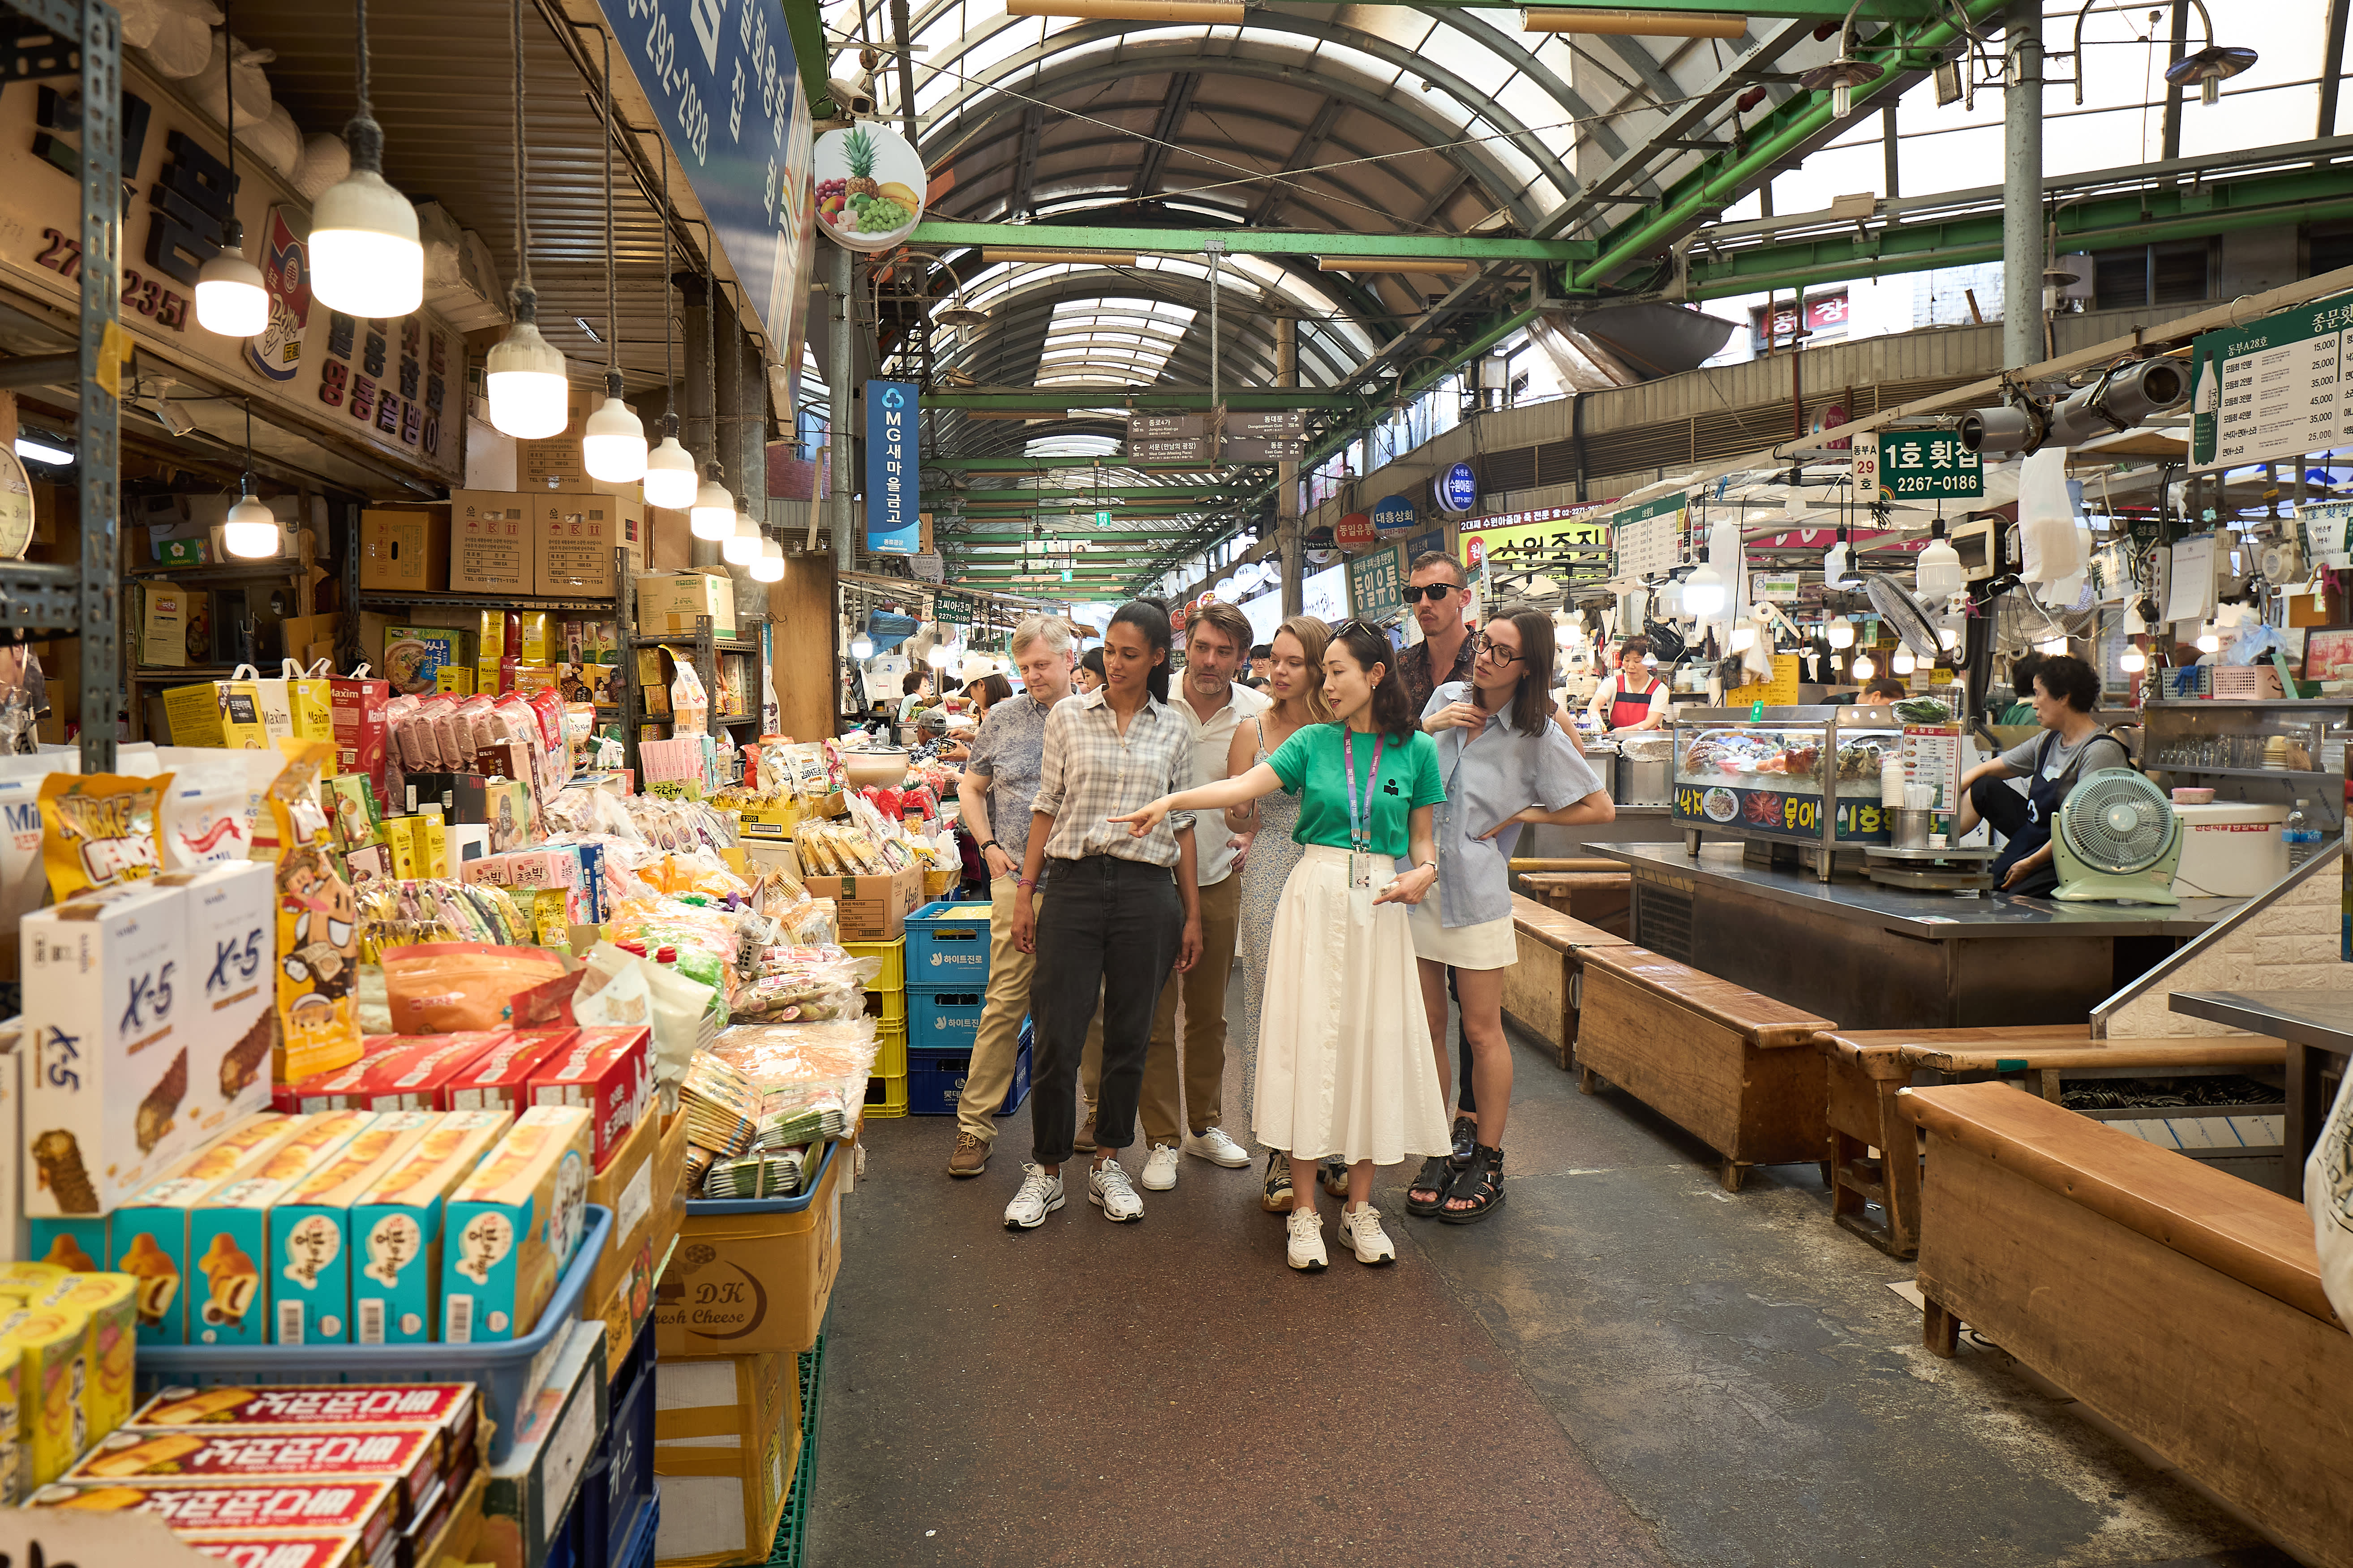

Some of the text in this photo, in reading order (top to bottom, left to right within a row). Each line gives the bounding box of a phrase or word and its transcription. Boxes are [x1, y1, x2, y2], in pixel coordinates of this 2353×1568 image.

[1815, 298, 1848, 322] 장
[2228, 336, 2268, 356] 동부A28호
[2241, 360, 2252, 369] 1인분
[2314, 339, 2335, 351] 15,000
[2240, 377, 2252, 386] 2인분
[2312, 358, 2334, 369] 25,000
[2239, 394, 2252, 403] 3인분
[2311, 376, 2333, 388] 35,000
[2238, 411, 2251, 420] 4인분
[2310, 394, 2333, 406] 45,000
[1265, 415, 1283, 423] 동대문
[2310, 412, 2332, 424] 35,000
[1182, 442, 1196, 450] 광장)
[1853, 444, 1876, 456] 동부A
[2223, 430, 2332, 457] 연어+소라 25,000
[886, 411, 902, 523] MG새마을금고
[1857, 461, 1874, 474] 29
[1859, 479, 1873, 490] 호
[1898, 475, 1976, 493] 2267-0186
[1376, 510, 1413, 524] 대흥상회
[1461, 510, 1550, 531] 2대째 수원아줌마 죽 전문
[1339, 523, 1373, 537] 동일유통
[1354, 565, 1398, 610] 동일유통
[262, 709, 289, 725] Maxim
[308, 709, 330, 724] Maxim
[368, 708, 386, 724] Maxim
[1680, 789, 1815, 829] 낙지 문어
[516, 867, 542, 883] 초코빅
[944, 955, 983, 964] 하이트진로
[120, 961, 176, 1038] X-5
[948, 1018, 980, 1028] 하이트진
[47, 1026, 81, 1091] X-5
[656, 1309, 745, 1324] resh Cheese
[246, 1390, 440, 1417] 빠다코코낫
[193, 1436, 403, 1467] 빠다코코낫
